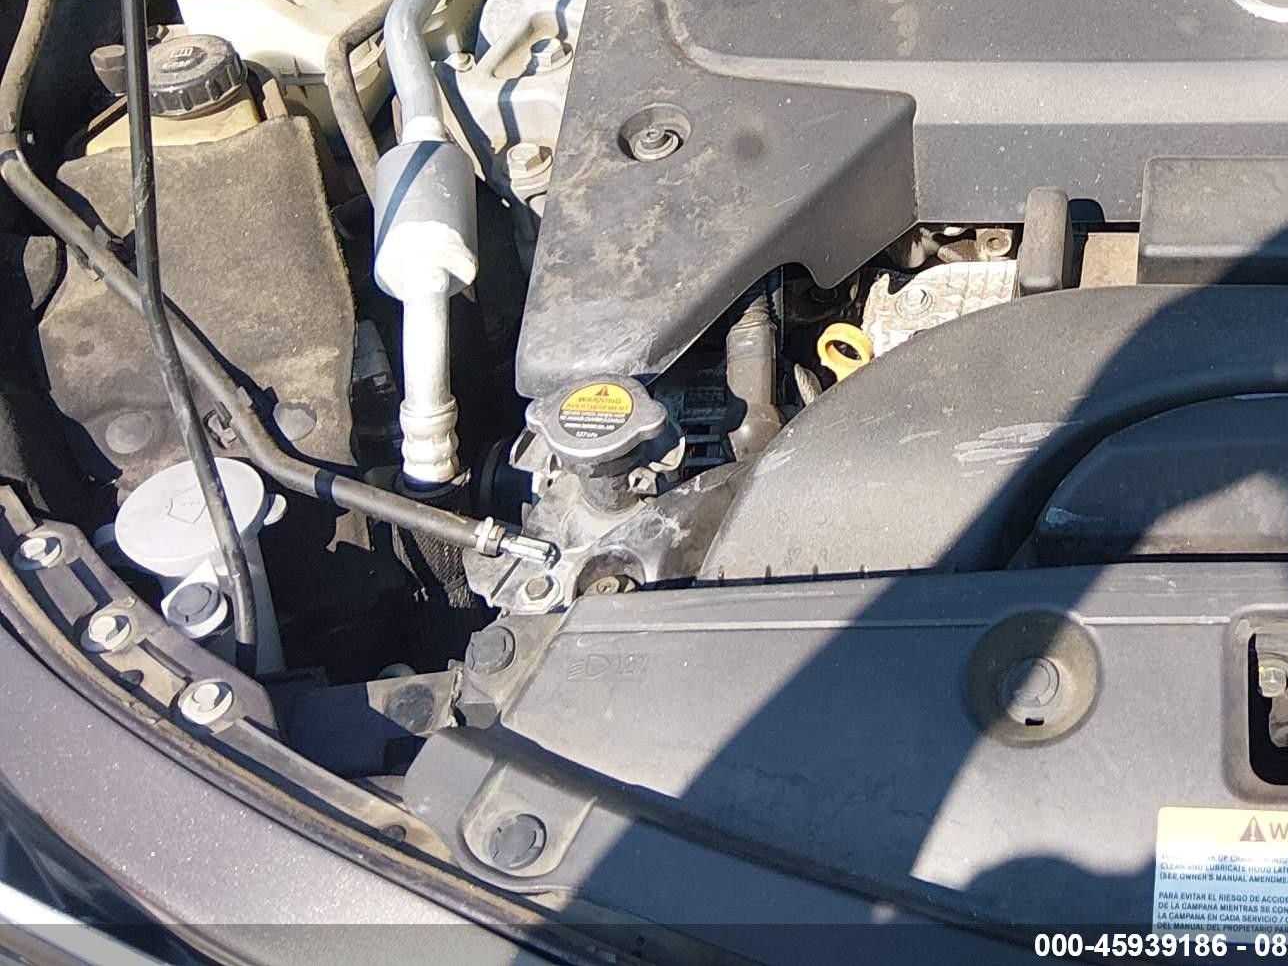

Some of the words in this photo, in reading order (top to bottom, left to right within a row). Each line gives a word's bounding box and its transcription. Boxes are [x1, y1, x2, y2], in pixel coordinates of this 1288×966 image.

[578, 396, 622, 404] WARNING
[1205, 864, 1246, 872] LUBRICATE
[1160, 872, 1178, 880] (SEE
[1159, 892, 1178, 900] PARA
[1180, 892, 1206, 900] EVITAR
[1218, 894, 1248, 902] RIESGO
[1158, 902, 1168, 910] DE
[1170, 902, 1180, 910] LA
[1182, 903, 1218, 911] CAMPANA
[1220, 904, 1258, 912] MIENTRAS
[1158, 912, 1167, 920] LA
[1168, 912, 1206, 921] CAMPANA
[1220, 914, 1240, 922] CADA
[1242, 915, 1278, 924] SERVICIO
[1157, 922, 1171, 930] DEL
[1173, 922, 1205, 931] MANUAL
[1206, 924, 1220, 932] DEL
[1222, 924, 1273, 933] PROPIETARIO
